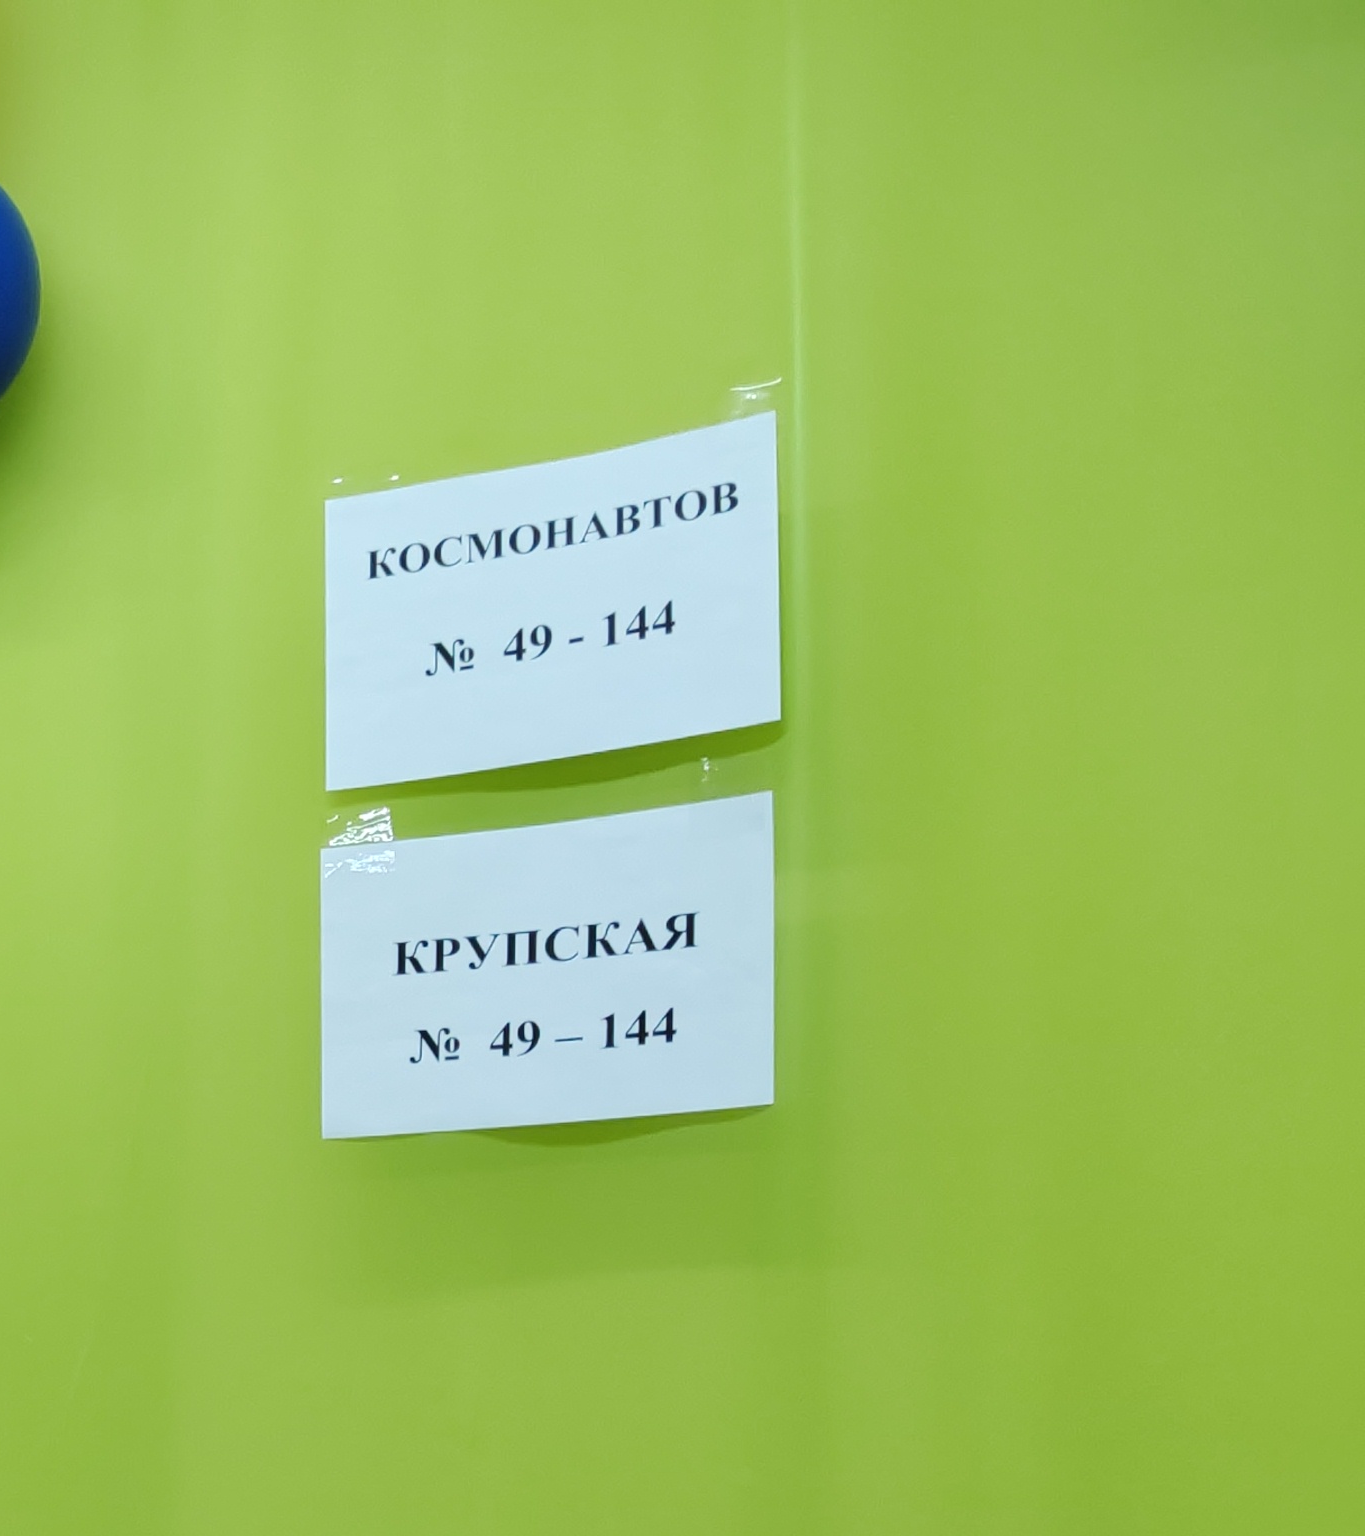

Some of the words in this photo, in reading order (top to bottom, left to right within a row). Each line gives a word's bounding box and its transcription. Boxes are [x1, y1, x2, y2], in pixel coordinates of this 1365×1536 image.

[367, 480, 741, 582] КОСМОНАВТОВ
[424, 637, 476, 678] №
[502, 623, 554, 663] 49
[604, 599, 677, 648] 144
[394, 910, 699, 977] КРУПСКАЯ
[408, 1026, 462, 1065] №
[488, 1019, 542, 1058] 49
[602, 1006, 679, 1050] 144
